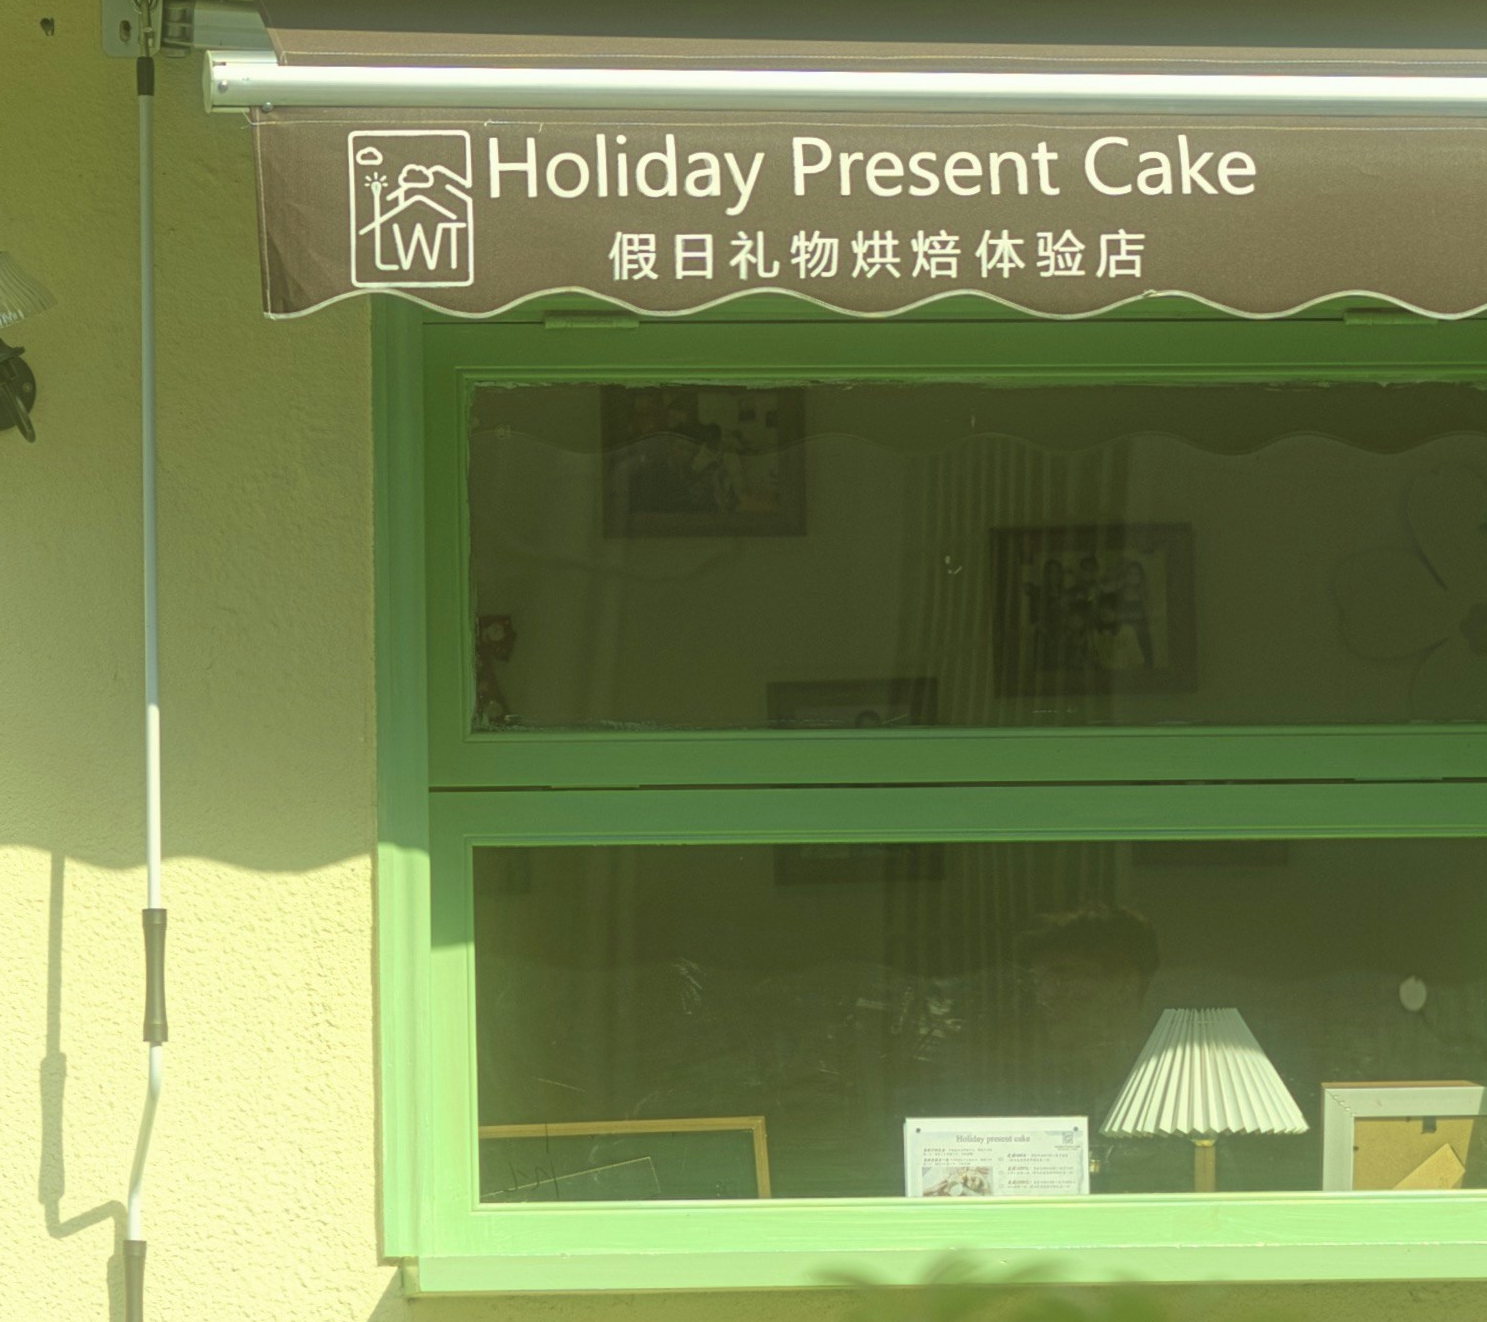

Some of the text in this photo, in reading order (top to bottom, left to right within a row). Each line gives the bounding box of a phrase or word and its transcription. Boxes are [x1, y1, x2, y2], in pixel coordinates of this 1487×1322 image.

[488, 134, 1257, 215] Holiday Present Cake
[608, 228, 1146, 281] 假日礼物烘焙体验店
[956, 1135, 1031, 1144] Holiday present cake
